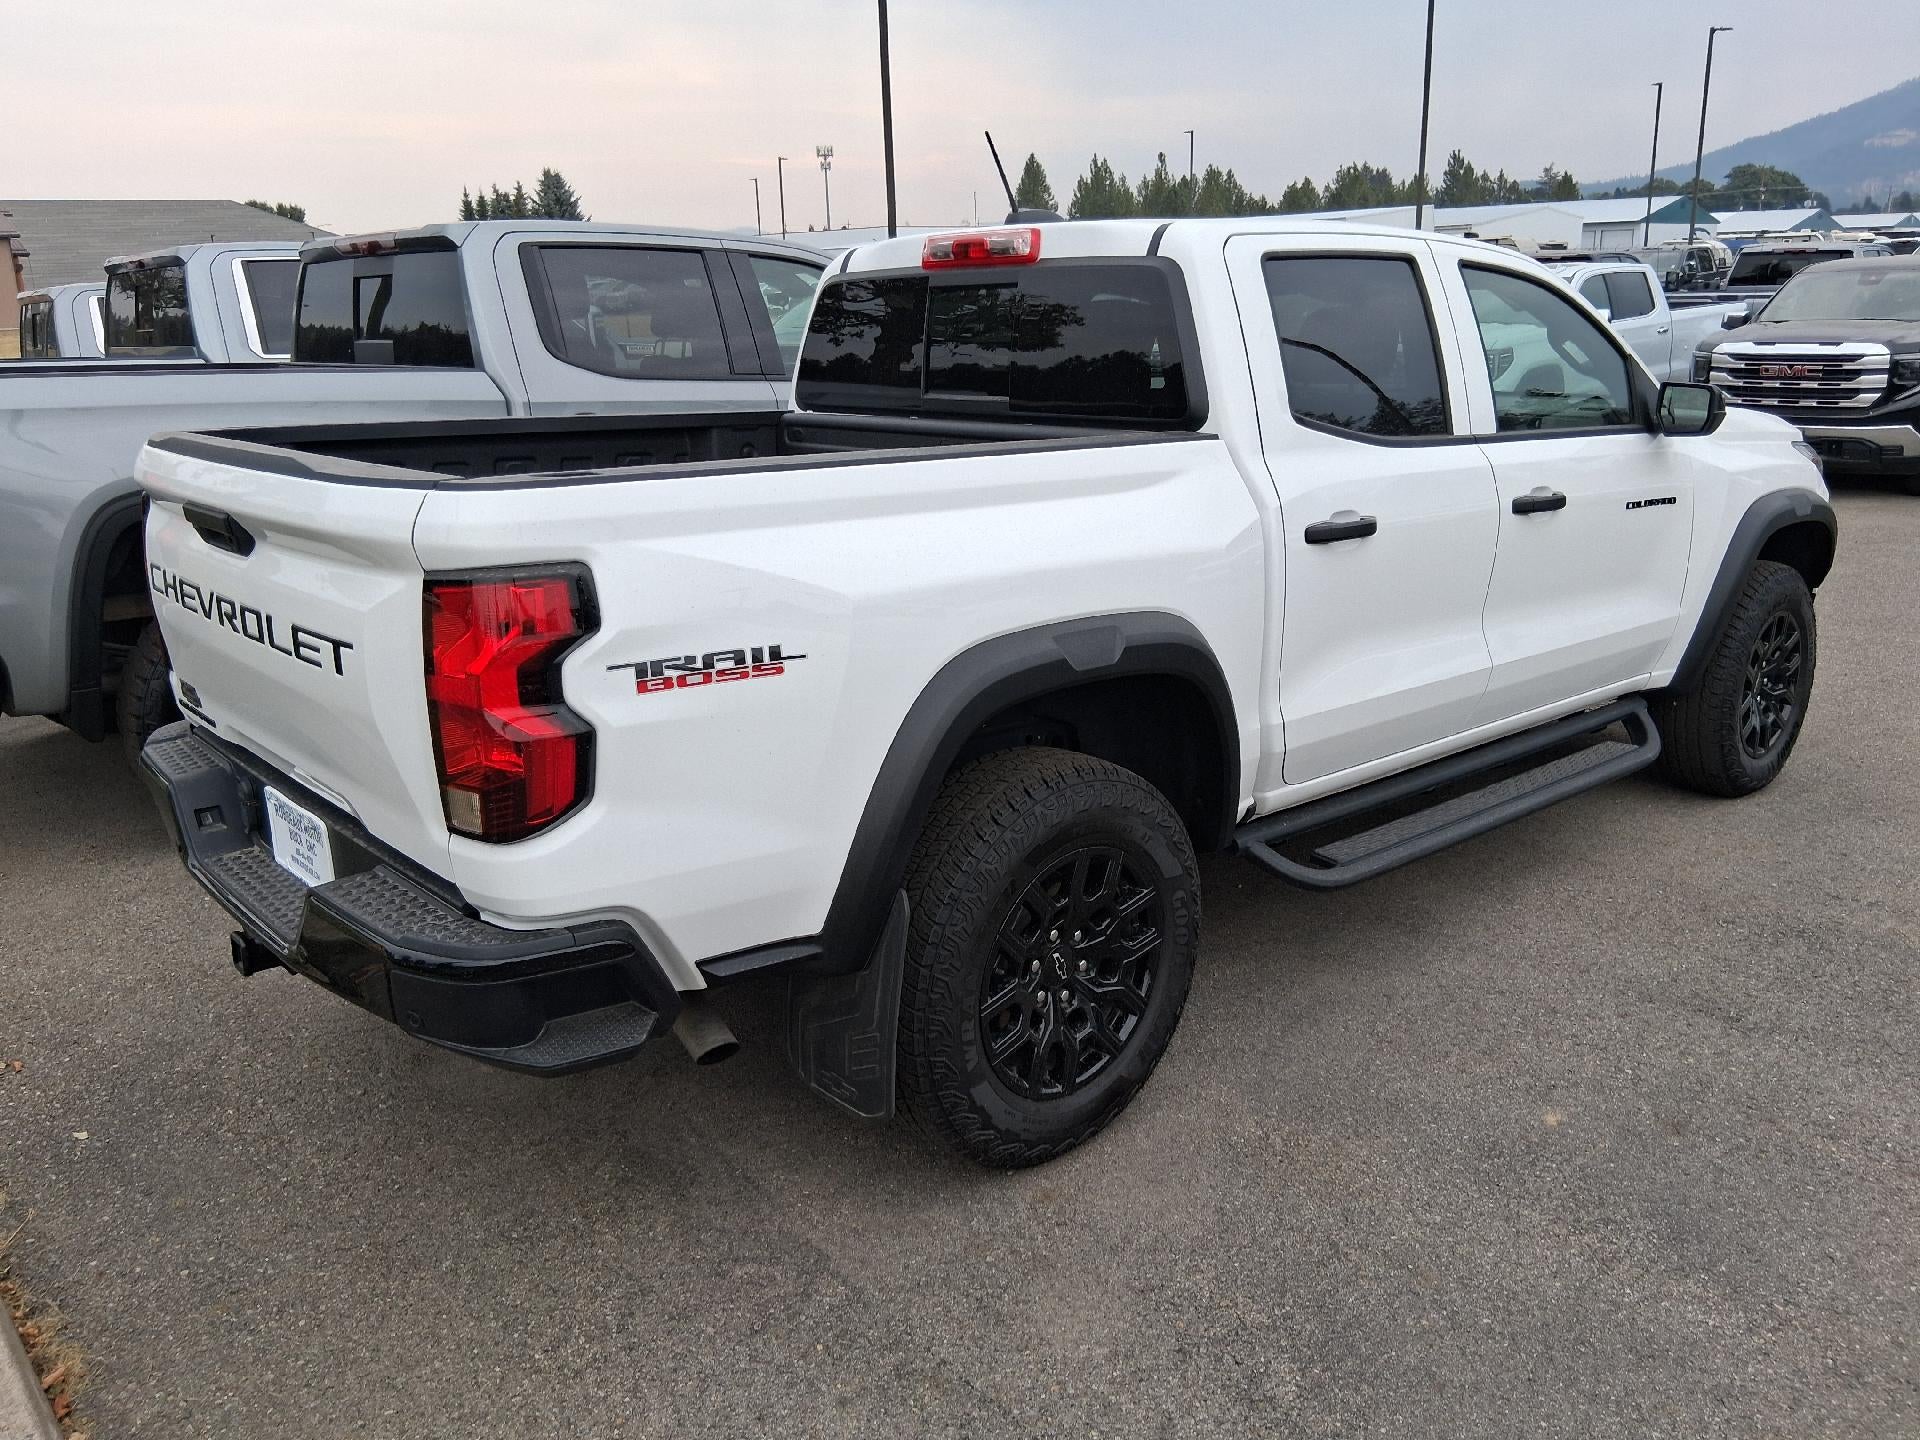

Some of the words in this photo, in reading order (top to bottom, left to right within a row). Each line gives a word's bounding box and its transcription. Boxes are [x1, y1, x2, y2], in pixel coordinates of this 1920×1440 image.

[1759, 365, 1824, 377] GMC
[1625, 497, 1677, 510] COLORADO
[150, 562, 353, 676] CHEVROLET
[606, 645, 807, 679] TRAIL
[636, 661, 785, 694] BOSS
